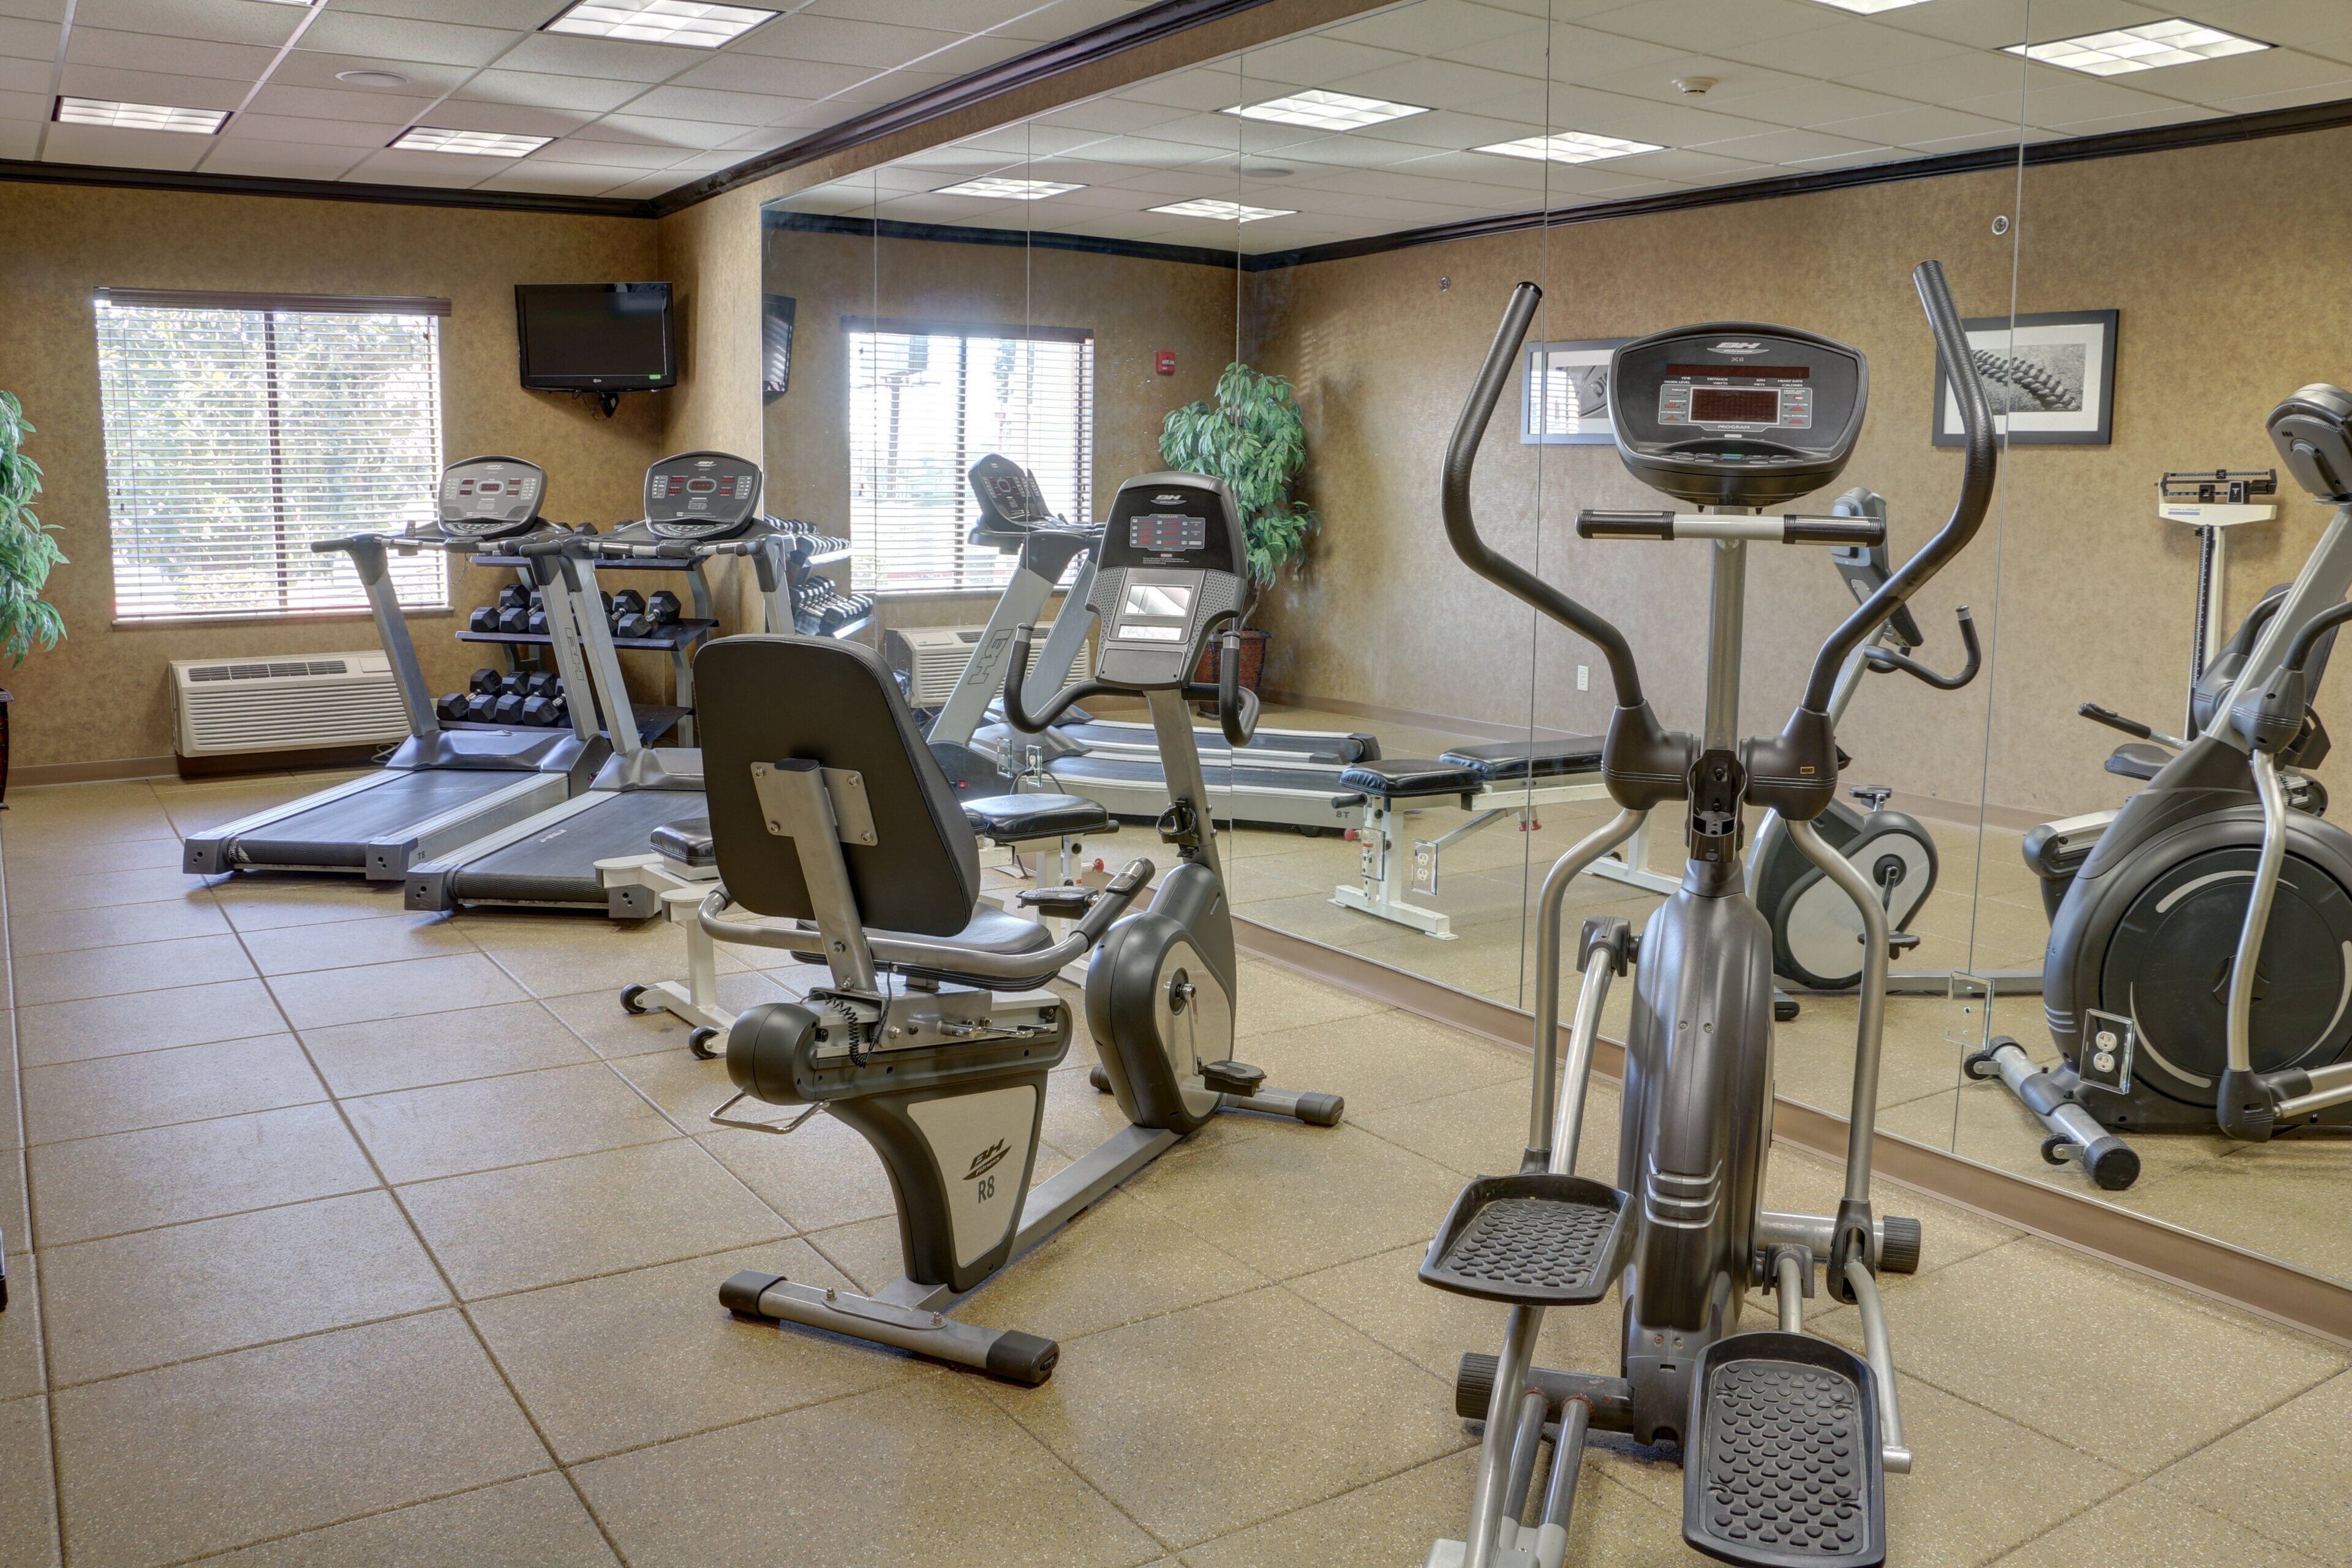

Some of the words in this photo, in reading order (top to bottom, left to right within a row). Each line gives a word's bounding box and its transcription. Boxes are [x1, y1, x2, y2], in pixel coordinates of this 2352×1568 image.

[417, 851, 426, 860] T8
[975, 1156, 1000, 1175] Fitness
[978, 1175, 995, 1204] R8
